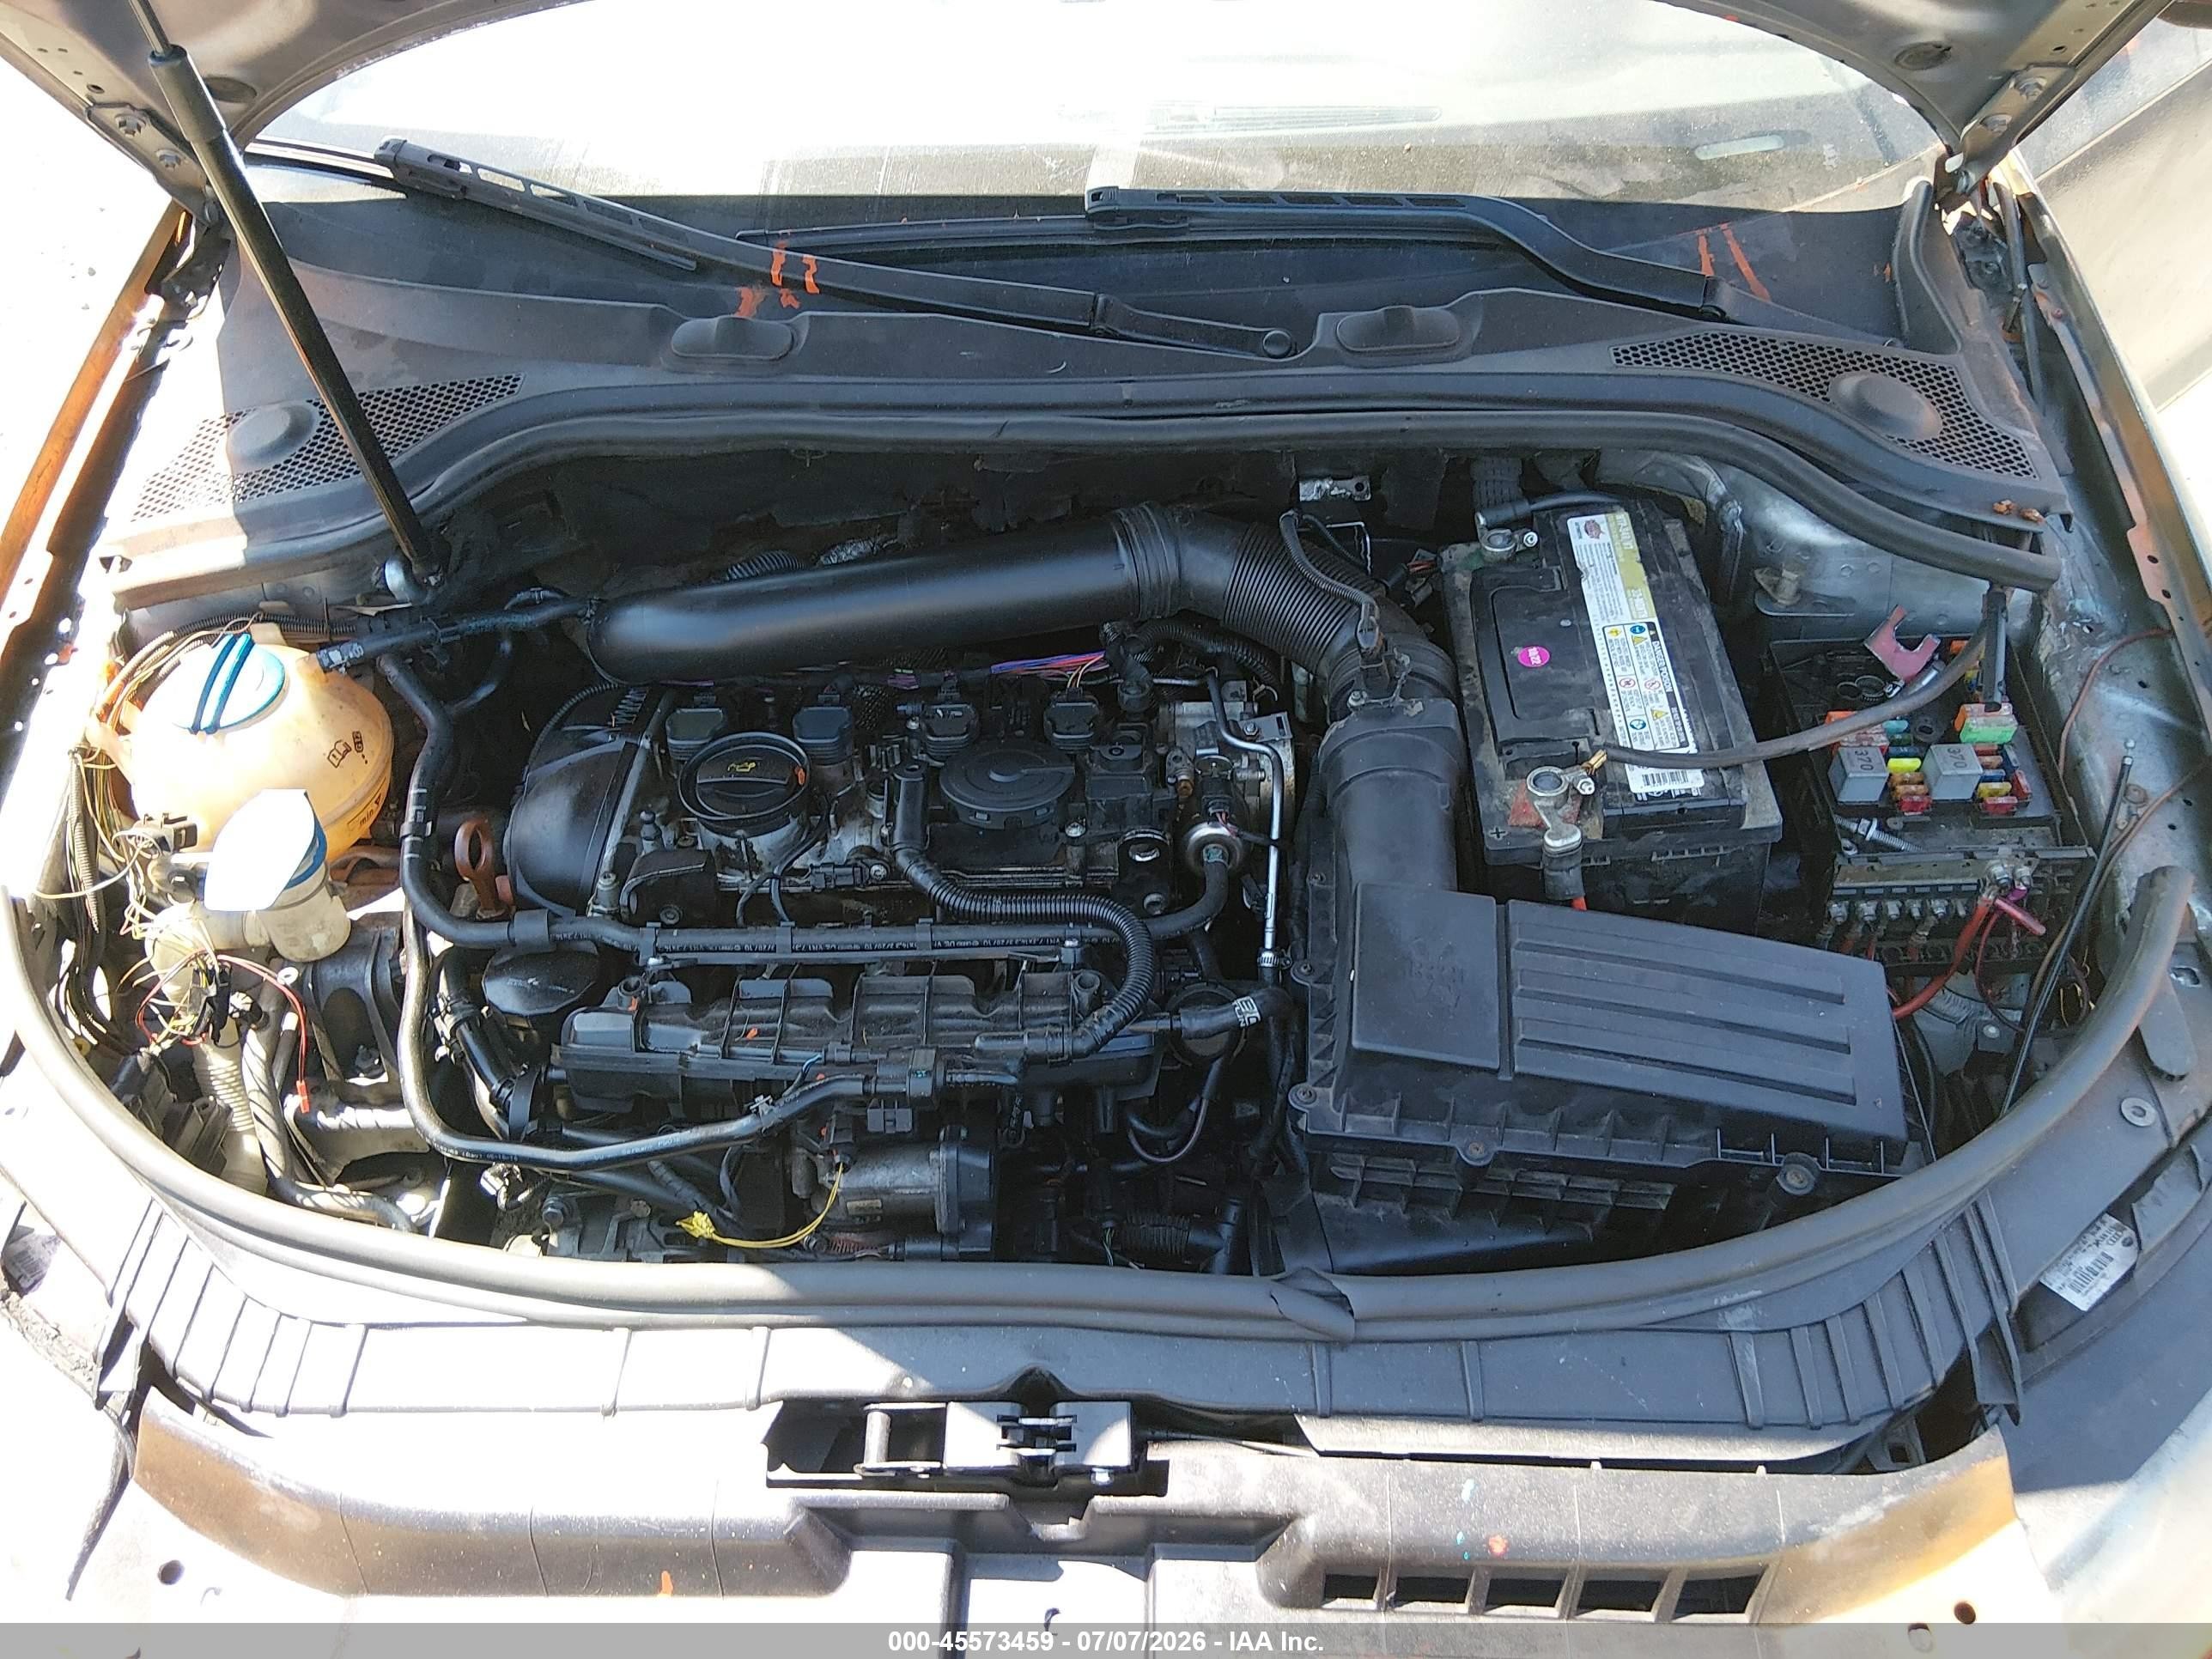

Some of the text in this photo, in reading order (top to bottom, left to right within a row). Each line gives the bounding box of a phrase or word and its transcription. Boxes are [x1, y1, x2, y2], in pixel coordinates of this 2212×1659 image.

[1854, 750, 1875, 771] 370
[1947, 747, 1968, 769] 370
[359, 809, 374, 826] min
